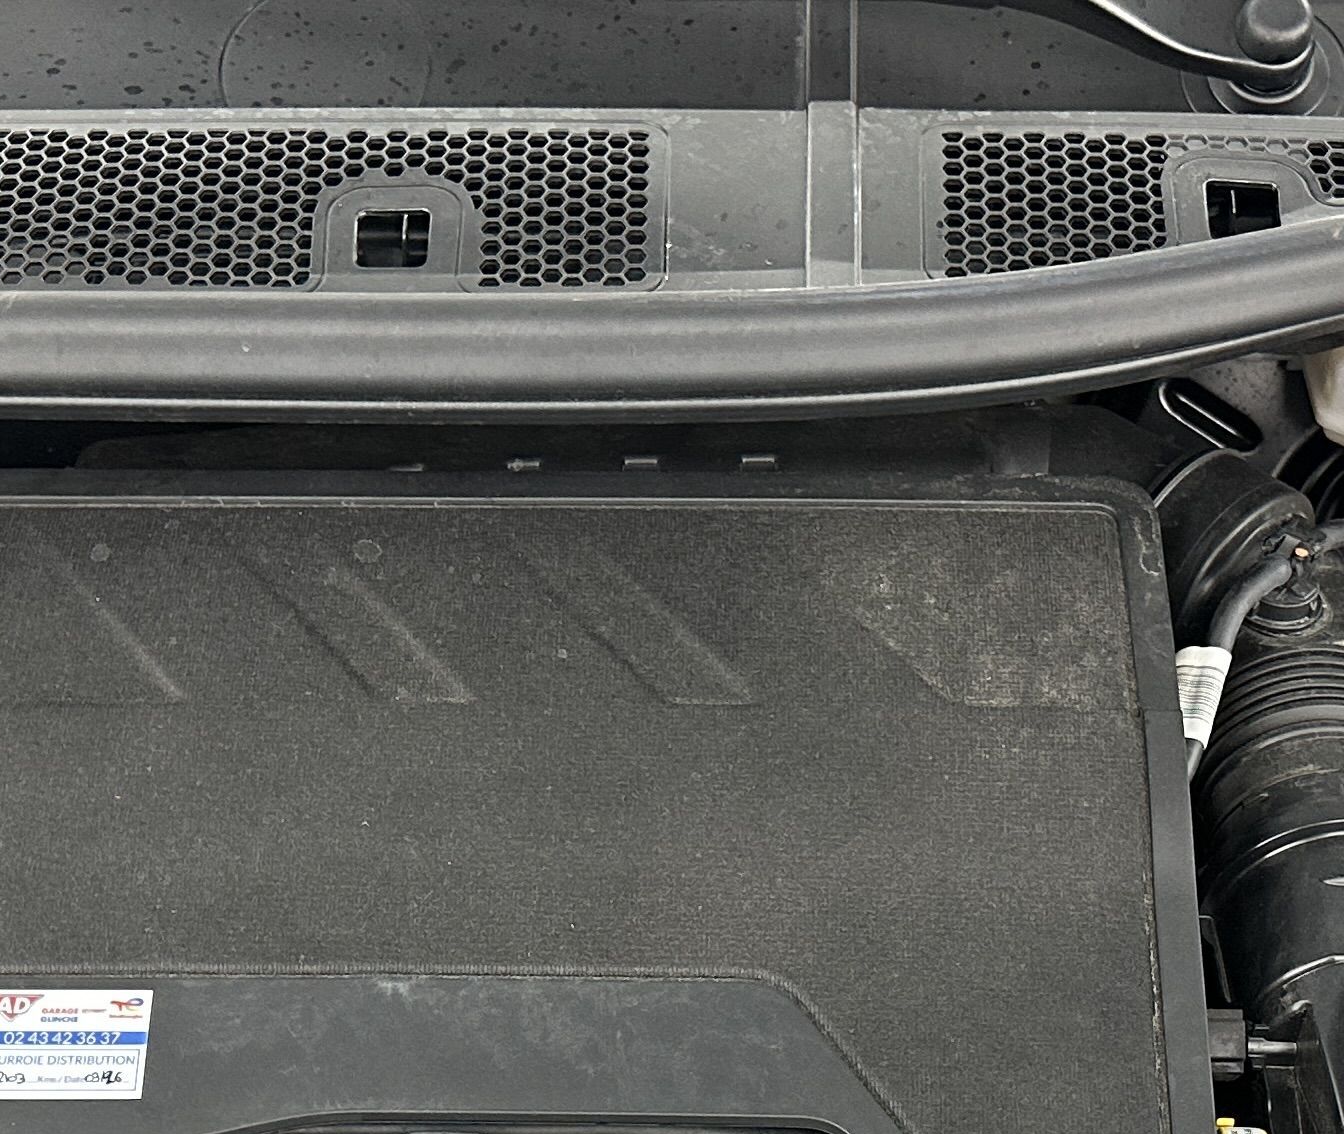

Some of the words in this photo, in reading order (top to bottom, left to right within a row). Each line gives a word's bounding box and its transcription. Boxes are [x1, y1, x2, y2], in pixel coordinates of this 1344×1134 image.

[4, 1032, 24, 1045] 02
[27, 1032, 49, 1045] 43
[51, 1032, 72, 1045] 42
[76, 1032, 97, 1045] 36
[99, 1032, 121, 1045] 37
[46, 1055, 136, 1066] DISTRIBUTION
